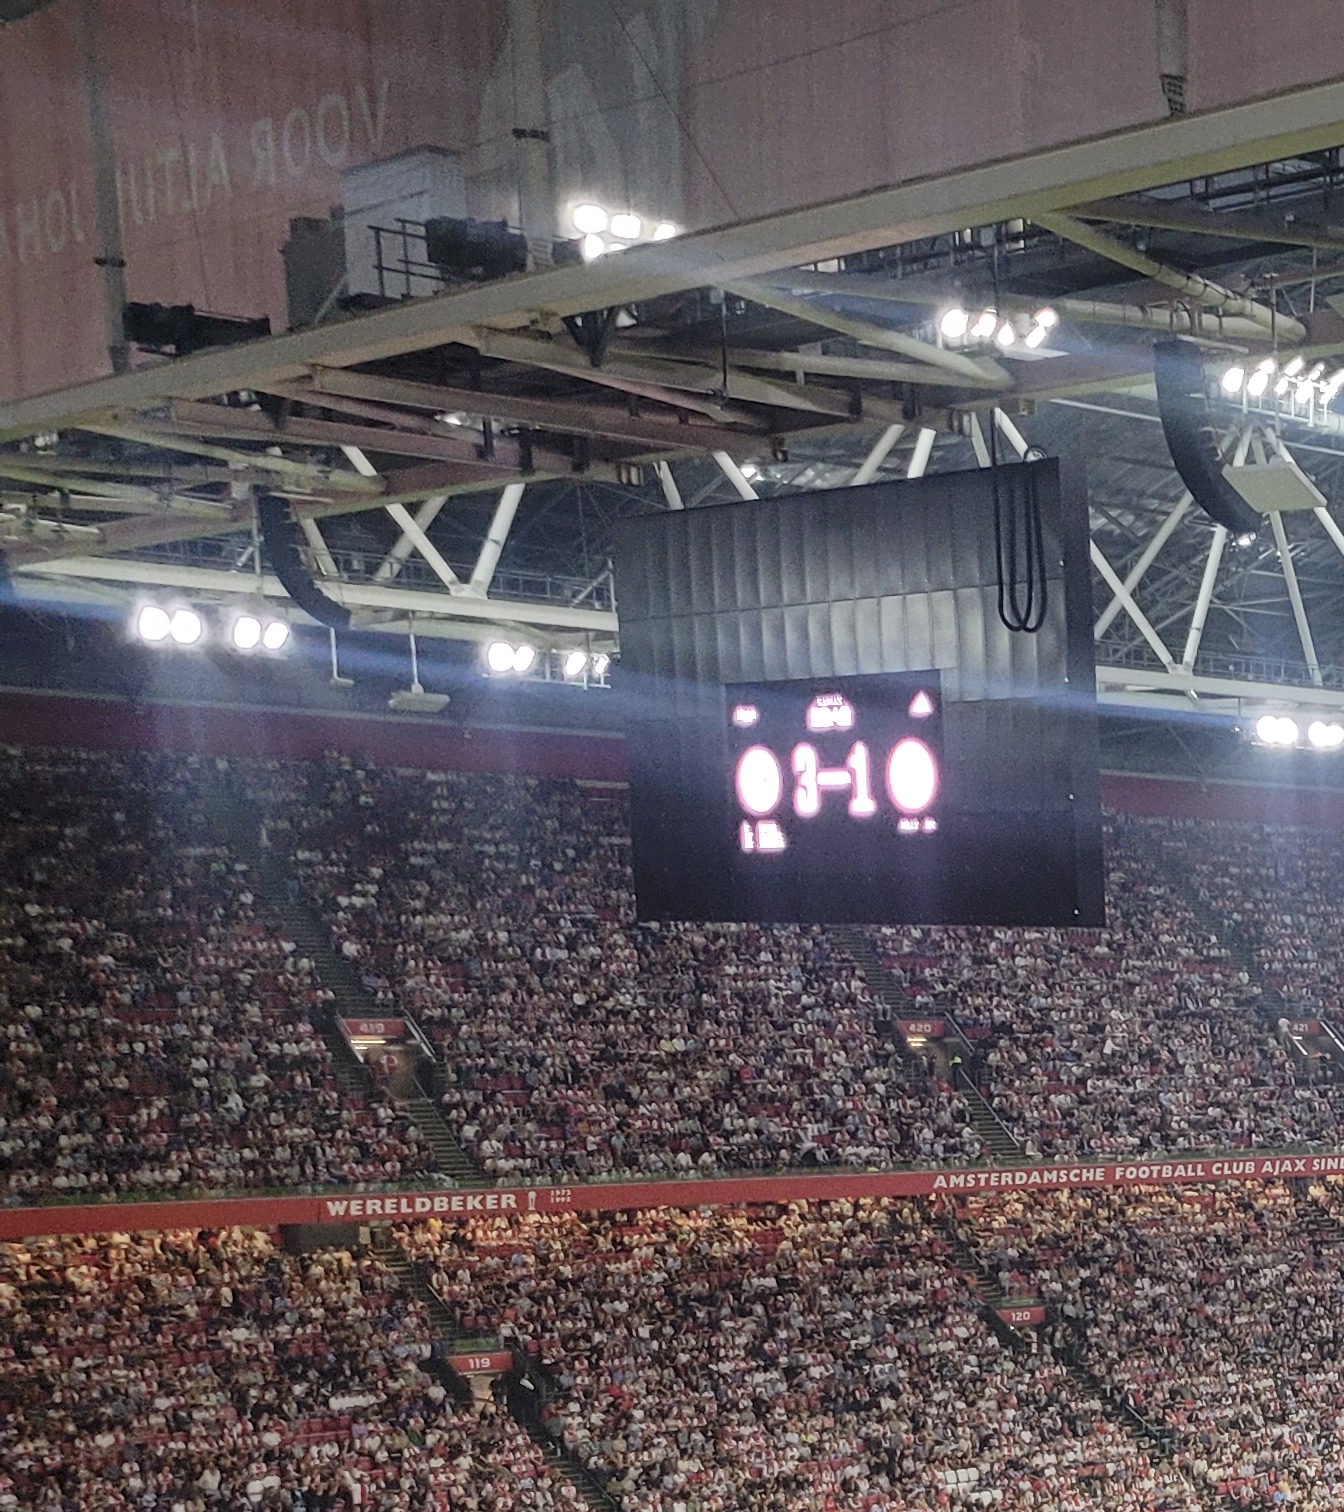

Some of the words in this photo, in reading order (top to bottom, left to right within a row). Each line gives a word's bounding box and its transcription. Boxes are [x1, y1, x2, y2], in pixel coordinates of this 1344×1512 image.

[933, 1167, 1106, 1190] AMSTERDAMSCHE
[1115, 1162, 1206, 1181] FOOTBALL
[1212, 1160, 1256, 1177] CLUB
[1260, 1158, 1307, 1176] AJAX
[326, 1193, 517, 1217] WERELDBEKER
